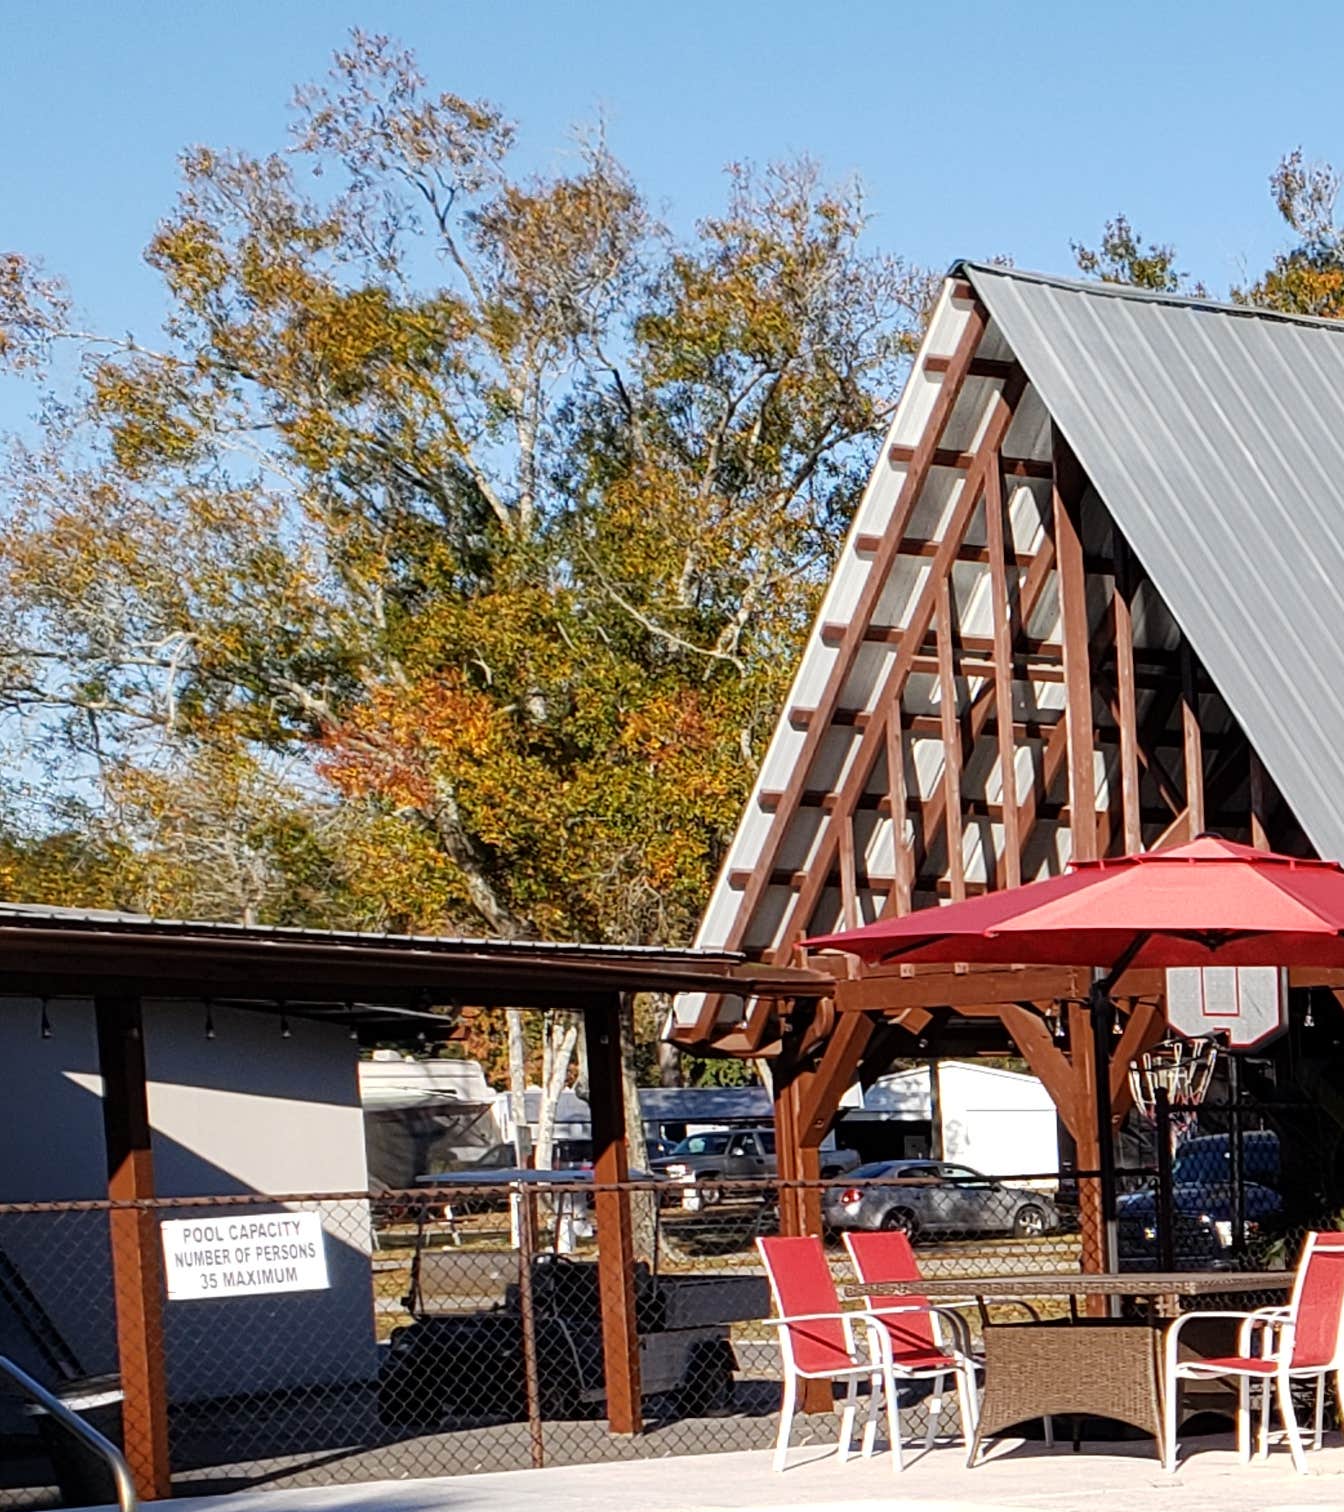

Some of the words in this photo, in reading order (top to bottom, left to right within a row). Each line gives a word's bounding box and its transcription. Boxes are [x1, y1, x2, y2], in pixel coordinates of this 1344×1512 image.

[183, 1227, 224, 1244] POOL
[229, 1221, 301, 1240] CAPACITY
[175, 1248, 231, 1268] NUMBER
[235, 1247, 251, 1264] OF
[256, 1243, 316, 1262] PERSONS
[200, 1273, 218, 1290] 35
[223, 1267, 298, 1287] MAXIMUM
